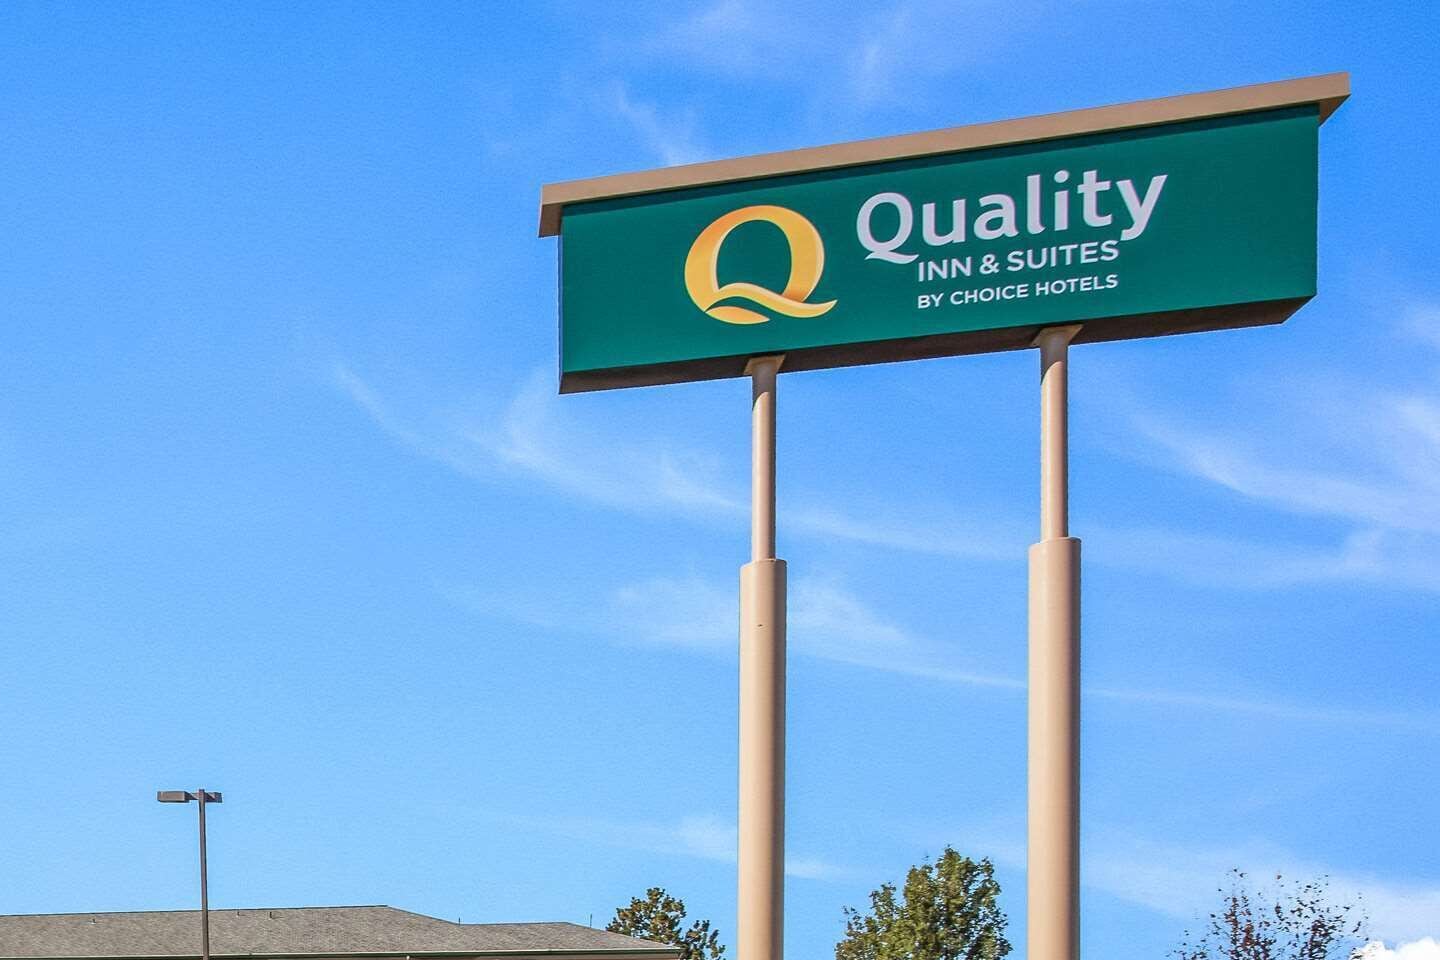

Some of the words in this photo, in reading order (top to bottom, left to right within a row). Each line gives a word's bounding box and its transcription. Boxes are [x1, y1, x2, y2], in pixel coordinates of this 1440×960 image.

[856, 170, 1168, 264] Quality
[684, 204, 839, 325] Q
[917, 292, 944, 309] BY
[950, 283, 1030, 306] CHOICE
[1035, 274, 1120, 297] HOTELS
[918, 256, 972, 282] INN
[979, 253, 1000, 275] &
[1007, 240, 1120, 273] SUITES
